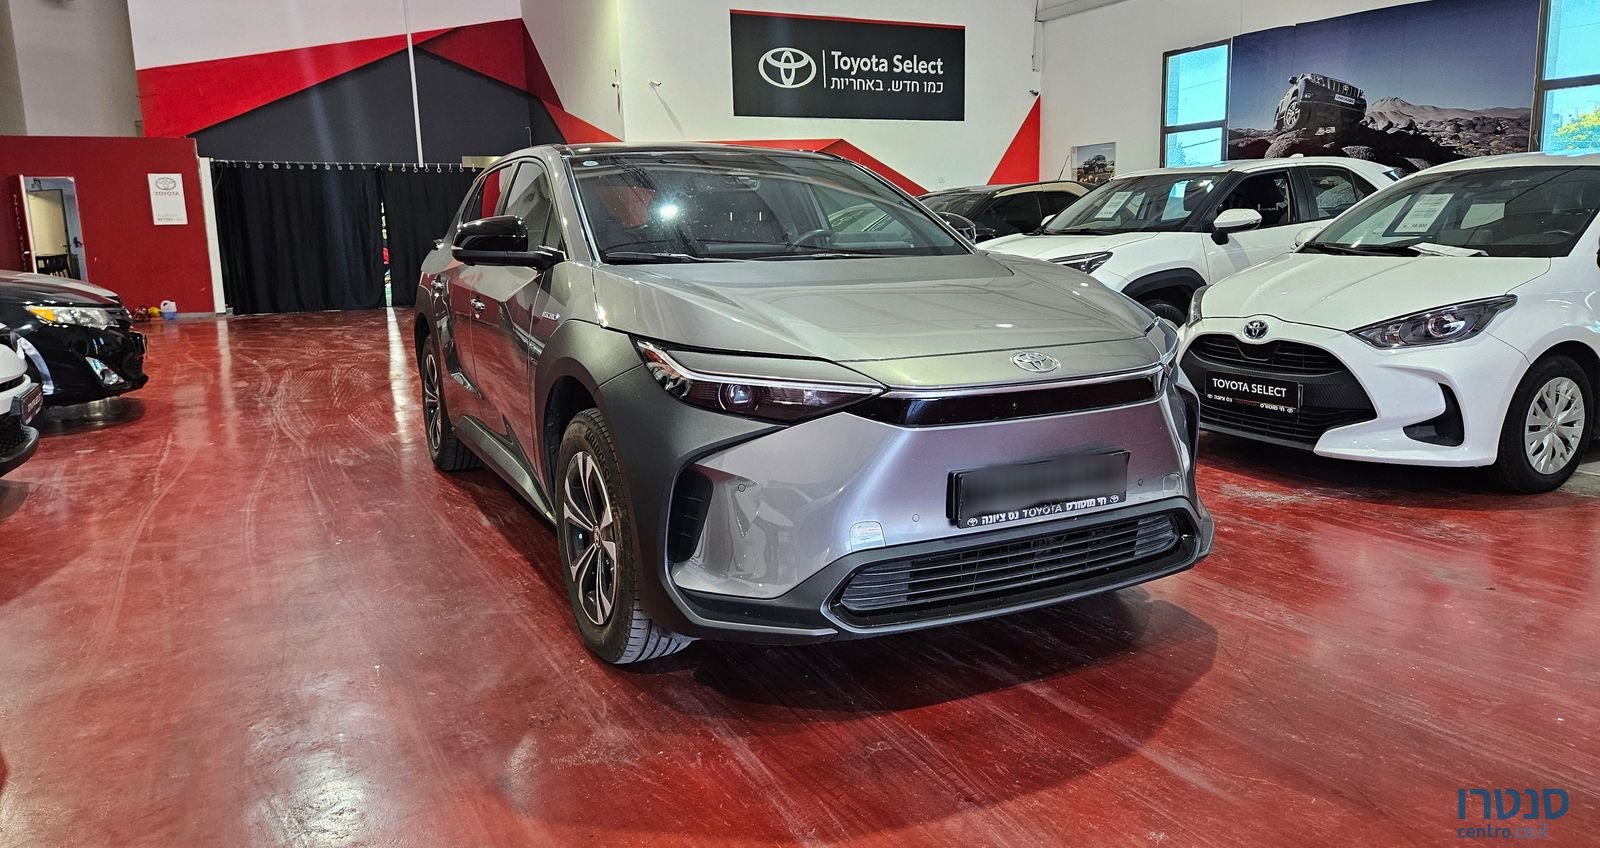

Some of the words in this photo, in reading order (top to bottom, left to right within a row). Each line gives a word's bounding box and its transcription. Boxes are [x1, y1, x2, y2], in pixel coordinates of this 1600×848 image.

[831, 51, 888, 75] Toyota
[893, 54, 944, 75] Select
[830, 76, 884, 92] באחריות
[887, 80, 919, 93] חדש.
[923, 81, 944, 94] כמו
[1212, 378, 1250, 392] TOYOTA
[1251, 384, 1287, 397] SELECT
[1007, 510, 1019, 521] נס
[1022, 504, 1062, 518] TOYOTA
[981, 512, 1006, 525] ציונה
